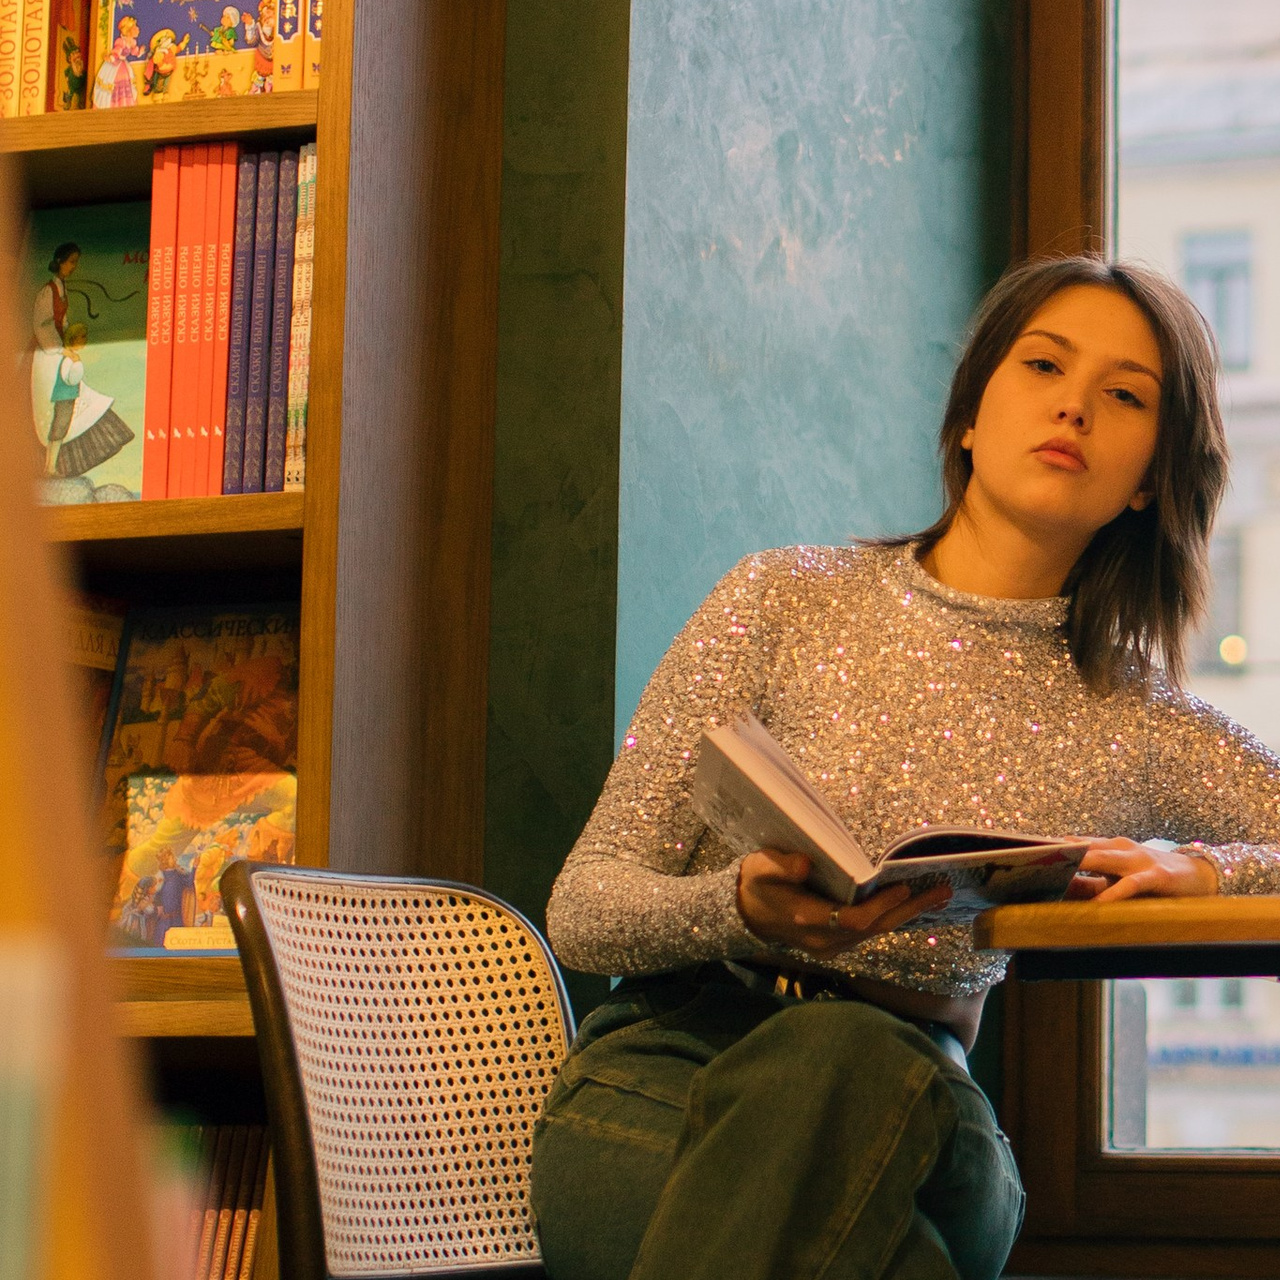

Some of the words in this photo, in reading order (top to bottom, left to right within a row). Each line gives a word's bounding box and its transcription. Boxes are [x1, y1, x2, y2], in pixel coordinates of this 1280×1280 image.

[152, 248, 162, 291] ОПЕРЫ
[163, 246, 173, 289] ОПЕРЫ
[179, 245, 189, 288] ОПЕРЫ
[192, 245, 202, 287] ОПЕРЫ
[206, 244, 216, 287] ОПЕРЫ
[220, 242, 230, 286] ОПЕРЫ
[236, 256, 246, 300] ВРЕМЕН
[256, 254, 266, 299] ВРЕМЕН
[276, 253, 287, 298] ВРЕМЕН
[150, 296, 160, 345] СКАЗКИ
[162, 295, 171, 344] СКАЗКИ
[177, 294, 186, 343] СКАЗКИ
[190, 293, 200, 342] СКАЗКИ
[204, 292, 214, 341] СКАЗКИ
[218, 291, 228, 340] СКАЗКИ
[233, 303, 243, 345] БЫЛЫХ
[253, 302, 264, 343] БЫЛЫХ
[274, 301, 285, 343] БЫЛЫХ
[230, 349, 241, 395] СКАЗКИ
[251, 347, 261, 393] СКАЗКИ
[272, 346, 283, 392] СКАЗКИ
